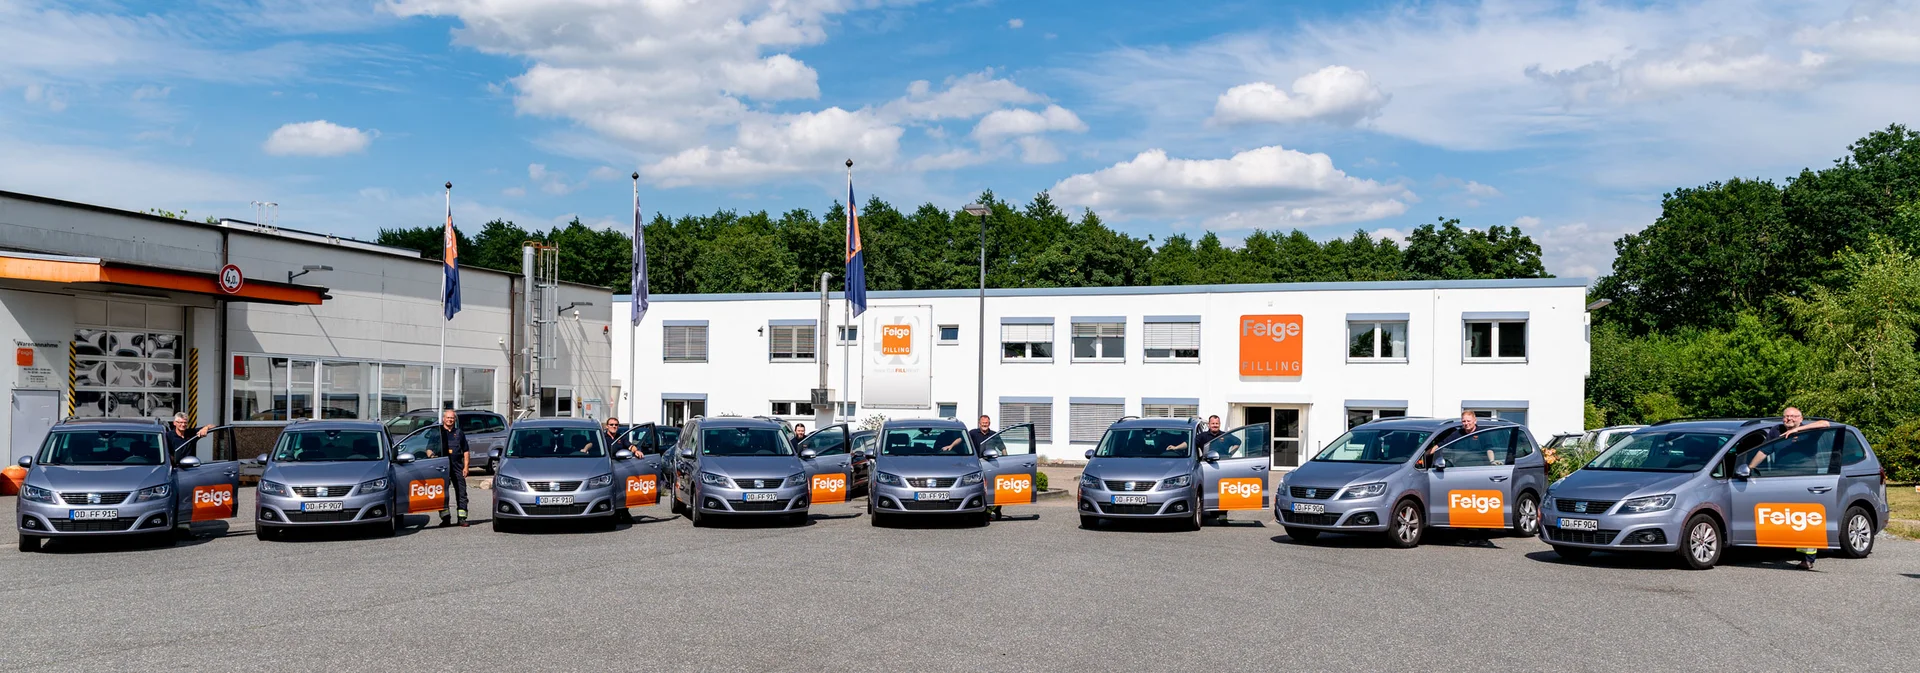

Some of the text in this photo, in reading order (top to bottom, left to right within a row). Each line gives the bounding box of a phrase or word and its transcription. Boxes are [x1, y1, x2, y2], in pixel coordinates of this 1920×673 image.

[883, 327, 910, 339] Feige
[1243, 319, 1300, 342] Feige
[1242, 361, 1300, 371] FILLING
[410, 483, 443, 500] Feige
[627, 479, 655, 495] Feige
[813, 477, 844, 492] Feige
[996, 478, 1030, 493] Feige
[1220, 481, 1260, 498] Feige
[194, 489, 231, 506] Feige
[1450, 494, 1501, 514] Feige
[1573, 520, 1582, 528] FF
[1757, 508, 1823, 532] Feige
